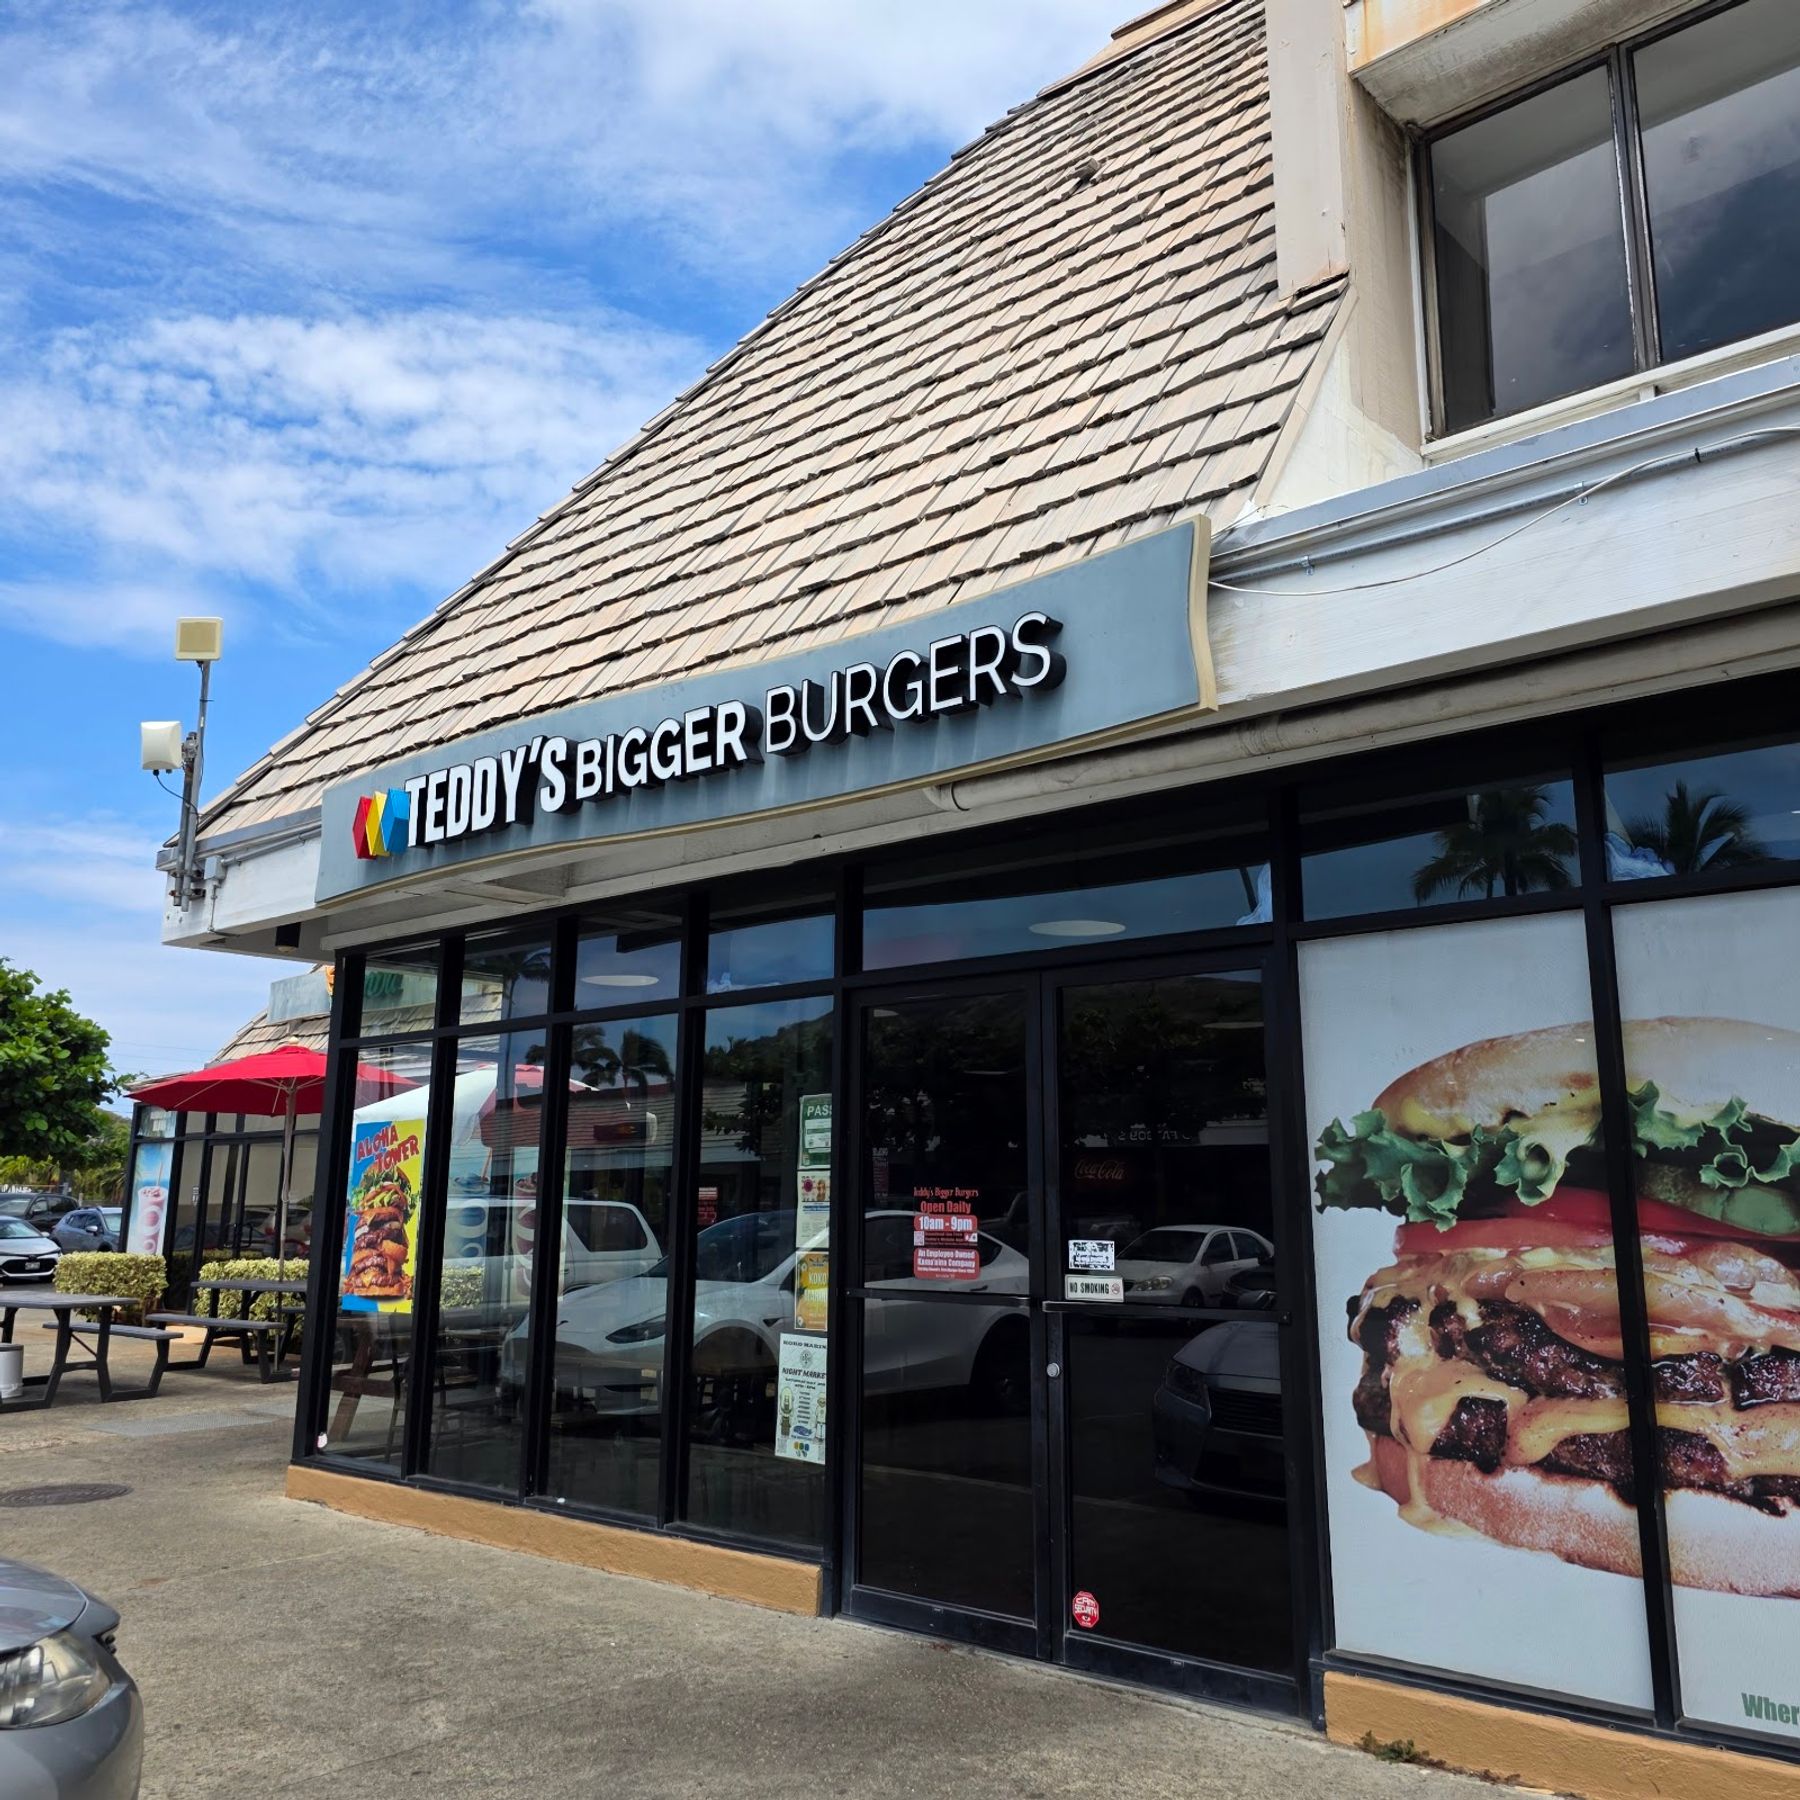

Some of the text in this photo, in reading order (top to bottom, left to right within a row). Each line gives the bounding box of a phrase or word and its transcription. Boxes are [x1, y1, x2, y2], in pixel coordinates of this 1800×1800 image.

[404, 610, 1054, 848] TEDDY'S BIGGER BURGERS
[807, 1104, 832, 1117] PAS
[357, 1124, 399, 1162] ALOHA
[375, 1135, 420, 1173] TOWER
[934, 1187, 954, 1199] Bigger
[955, 1187, 979, 1199] Burgers
[920, 1200, 972, 1214] Open Daily
[918, 1216, 944, 1230] 10am
[950, 1216, 973, 1232] 9pm
[1069, 1282, 1109, 1294] NO SMOKING
[782, 1367, 826, 1379] NIGHT MARKE
[1741, 1692, 1800, 1725] Wher
